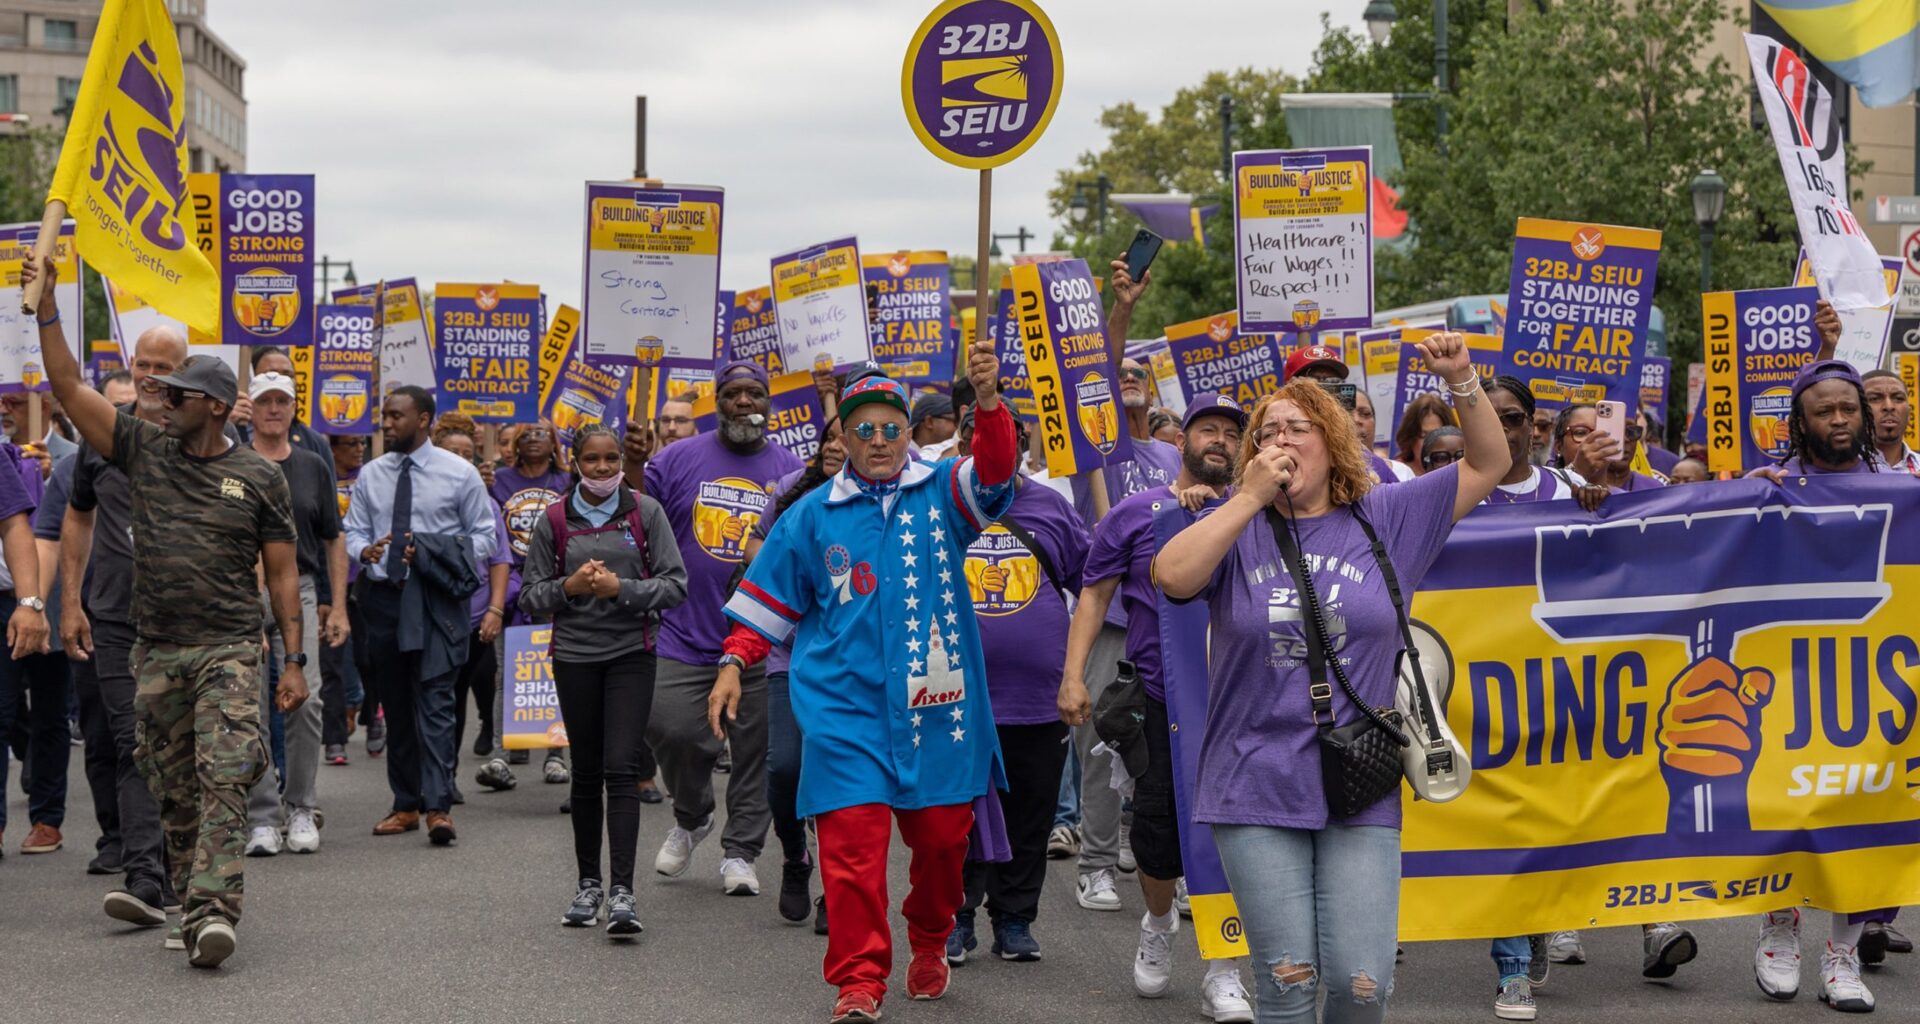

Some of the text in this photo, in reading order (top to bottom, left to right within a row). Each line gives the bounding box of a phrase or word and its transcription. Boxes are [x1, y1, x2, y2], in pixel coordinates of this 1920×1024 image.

[939, 21, 1031, 55] 32BJ
[939, 103, 1028, 137] SEIU
[1250, 170, 1352, 189] BUILDING JUSTICE
[89, 135, 186, 251] SEIU
[228, 189, 303, 209] GOOD
[193, 194, 213, 251] SEIU
[229, 211, 304, 233] JOBS
[602, 206, 706, 225] BUILDING JUSTICE
[229, 236, 305, 250] STRONG
[229, 253, 305, 263] COMMUNITIES
[819, 254, 847, 270] JUSTICE
[1243, 255, 1275, 276] Fair
[1524, 257, 1643, 287] 32BJ SEIU
[238, 277, 294, 289] BUILDING JUSTICE
[601, 269, 668, 300] Strong
[903, 277, 941, 292] SEIU
[1050, 277, 1092, 303] GOOD
[1522, 279, 1640, 306] STANDING
[878, 292, 941, 307] ANDING
[321, 315, 374, 330] GOOD
[443, 311, 531, 328] 32BJ SEIU
[874, 306, 941, 322] GETHER
[1055, 301, 1099, 333] JOBS
[1520, 299, 1638, 327] TOGETHER
[1744, 303, 1811, 326] GOOD
[443, 327, 531, 342] STANDING
[732, 325, 777, 346] STANDI
[886, 320, 943, 342] FAIR
[1021, 290, 1048, 362] SEIU
[1853, 327, 1872, 340] to
[320, 332, 373, 349] JOBS
[543, 318, 571, 363] SEIU
[873, 341, 944, 356] ONTRACT
[876, 333, 887, 344] A
[1059, 332, 1105, 355] STRONG
[1517, 319, 1634, 357] FOR FAIR
[1537, 336, 1549, 350] A
[1710, 313, 1730, 374] SEIU
[1744, 326, 1812, 351] JOBS
[320, 351, 373, 363] STRONG
[443, 342, 531, 358] TOGETHER
[1064, 352, 1108, 369] COMMUNITIES
[1182, 343, 1225, 365] 32BJ
[1745, 351, 1815, 370] STRONG
[444, 357, 531, 380] FOR FAIR
[1016, 365, 1026, 376] A
[1184, 345, 1272, 379] STANDING
[1513, 350, 1631, 376] CONTRACT
[460, 368, 470, 379] A
[568, 359, 622, 390] STRONG
[1188, 360, 1275, 392] TOGETHER
[444, 379, 531, 394] CONTRACT
[1535, 383, 1564, 395] BUILDING
[767, 404, 812, 431] SEIU
[1036, 375, 1066, 452] 32BJ
[1712, 385, 1734, 449] 32BJ
[766, 423, 817, 446] DING
[703, 486, 740, 501] BUILDING
[1264, 656, 1305, 669] Stronger
[513, 694, 560, 708] DING
[911, 687, 963, 707] Sixers
[514, 707, 556, 721] SEIU
[1469, 651, 1648, 770] DING
[1788, 761, 1896, 797] SEIU
[1605, 872, 1793, 908] 32BJ SEIU
